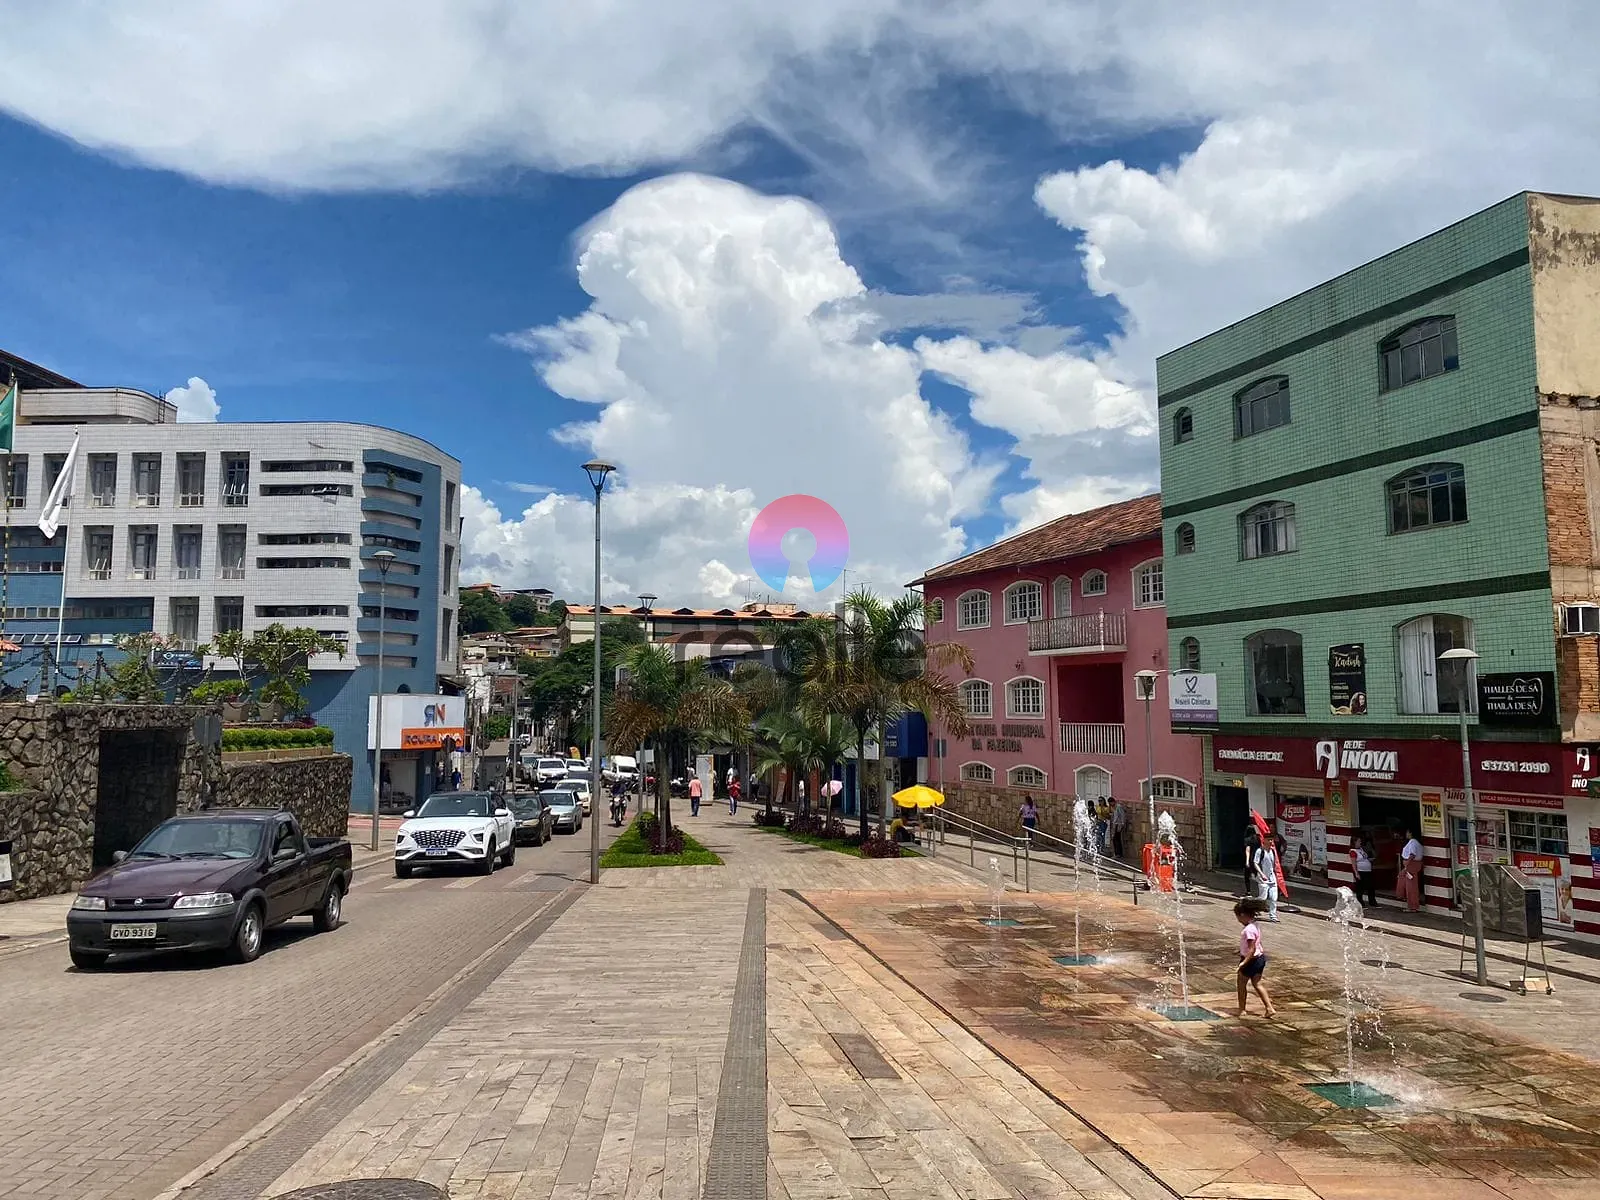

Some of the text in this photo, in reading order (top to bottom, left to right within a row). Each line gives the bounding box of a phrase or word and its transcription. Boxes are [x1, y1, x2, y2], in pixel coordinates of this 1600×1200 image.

[1001, 723, 1045, 738] MUNICIPAL
[972, 739, 1023, 753] DA FAZENDA
[1344, 741, 1366, 749] REDE
[1341, 750, 1398, 772] INOVA
[1520, 762, 1550, 774] 2090
[1571, 778, 1588, 788] INO
[1422, 804, 1441, 818] 70%
[132, 928, 154, 937] 9316
